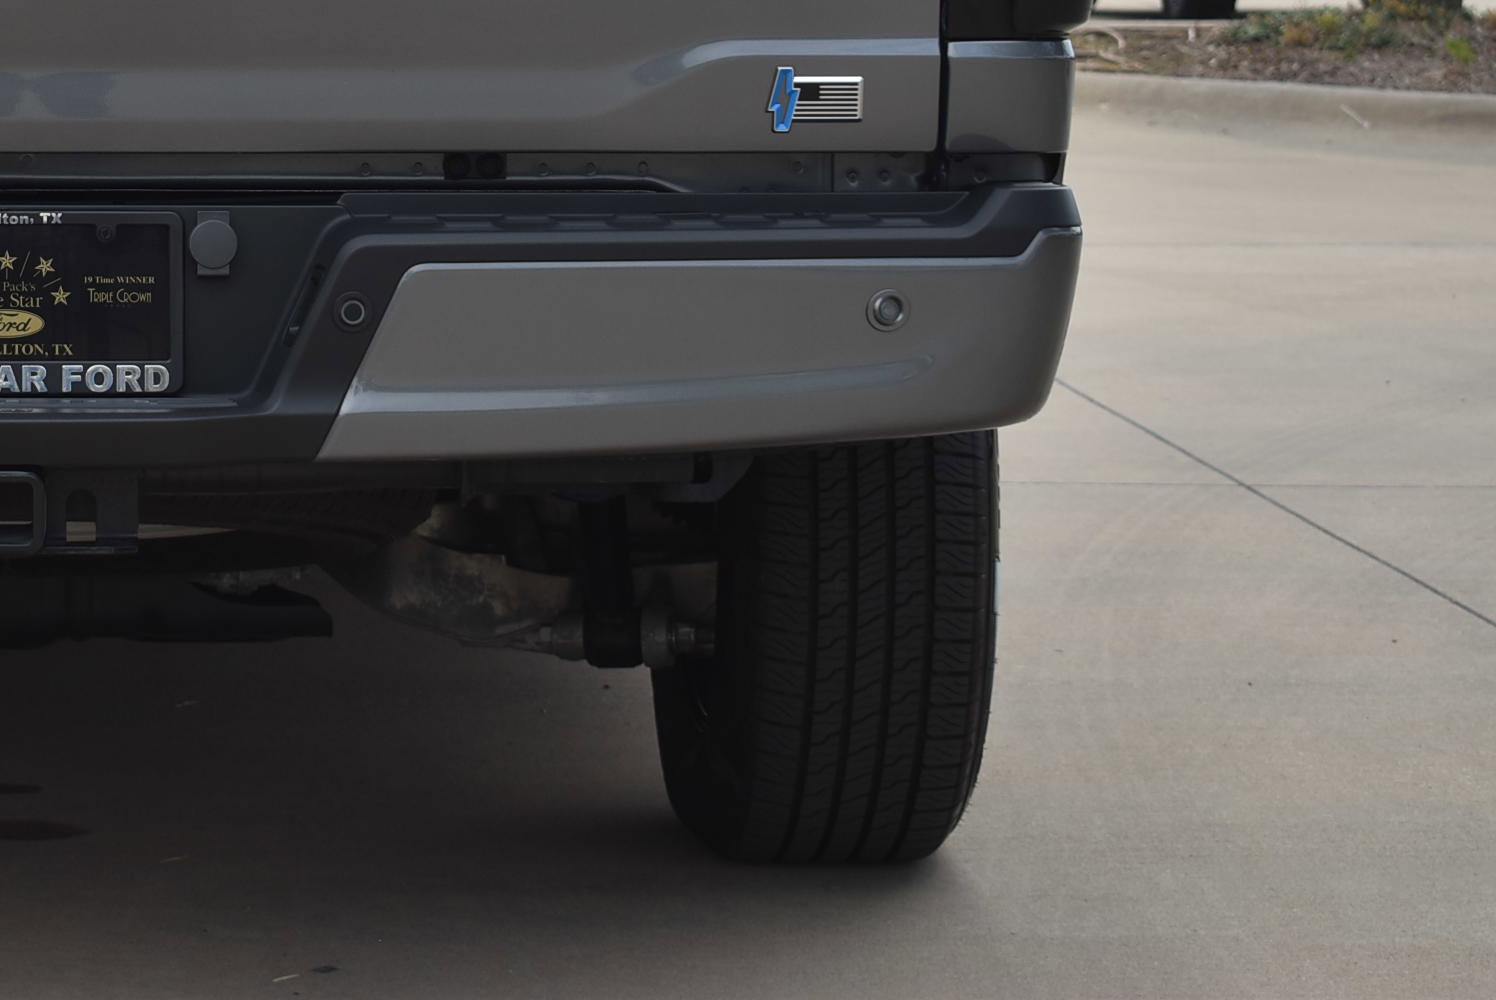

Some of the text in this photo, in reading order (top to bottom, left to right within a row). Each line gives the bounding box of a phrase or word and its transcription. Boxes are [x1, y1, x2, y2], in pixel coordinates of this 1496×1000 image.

[39, 212, 64, 225] TX
[3, 280, 36, 292] Pack's
[84, 275, 156, 284] 19 Time WINNER
[9, 292, 44, 308] Star
[87, 287, 114, 303] TRIPLE
[52, 343, 74, 356] TX
[61, 364, 171, 394] FORD
